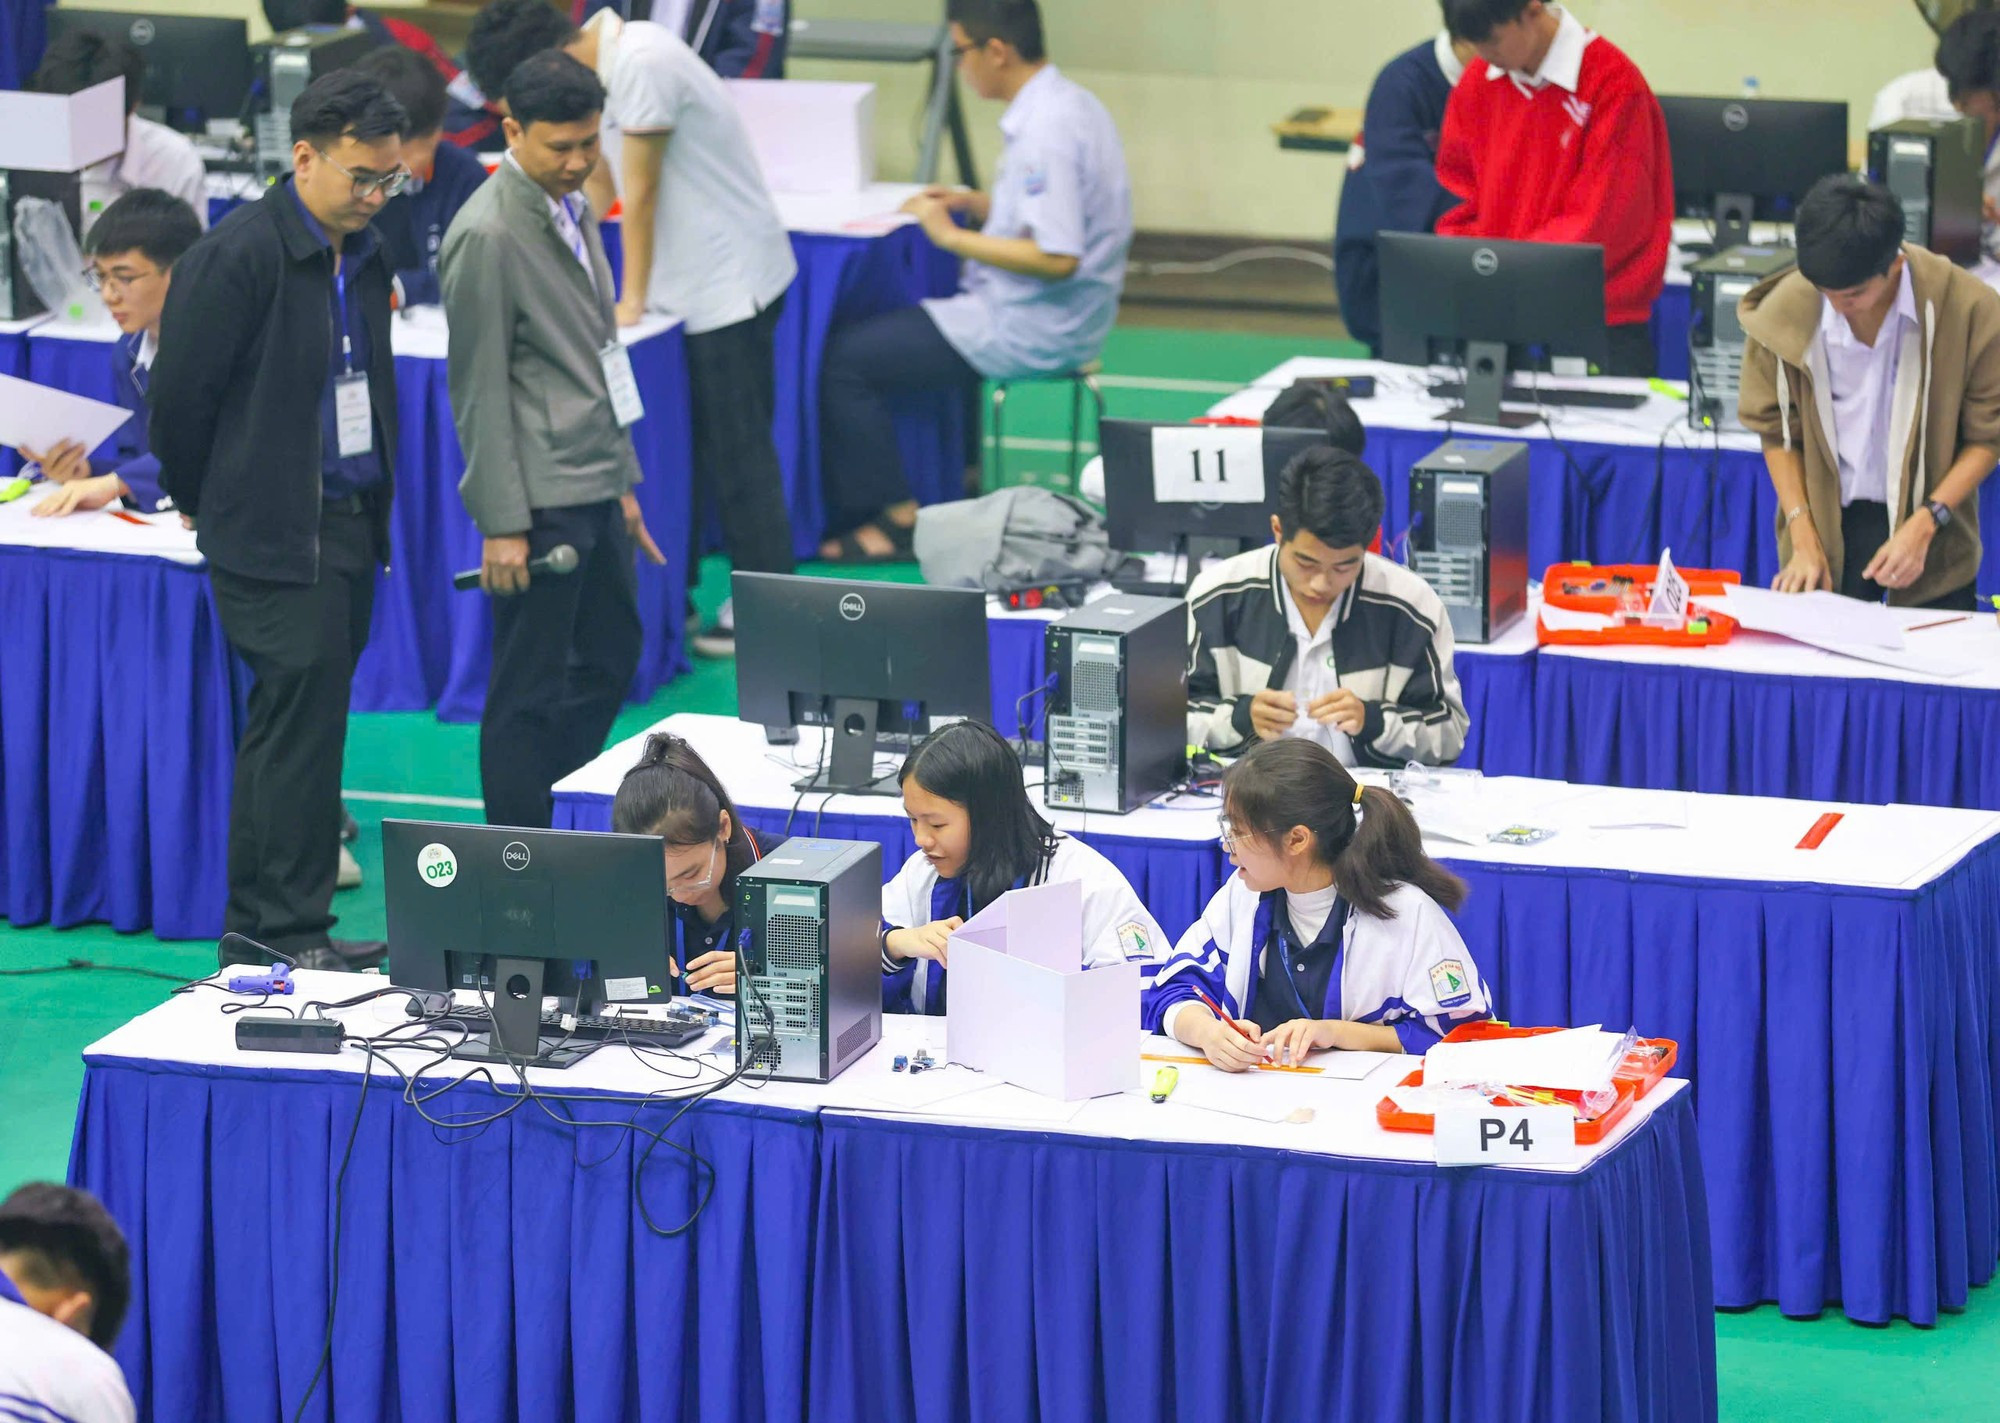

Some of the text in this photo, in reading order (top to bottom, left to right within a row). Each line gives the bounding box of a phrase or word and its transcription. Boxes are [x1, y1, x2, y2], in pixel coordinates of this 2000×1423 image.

[1190, 449, 1229, 482] 11
[843, 602, 863, 611] DELL
[506, 852, 527, 860] DELL
[1480, 1118, 1533, 1151] P4
